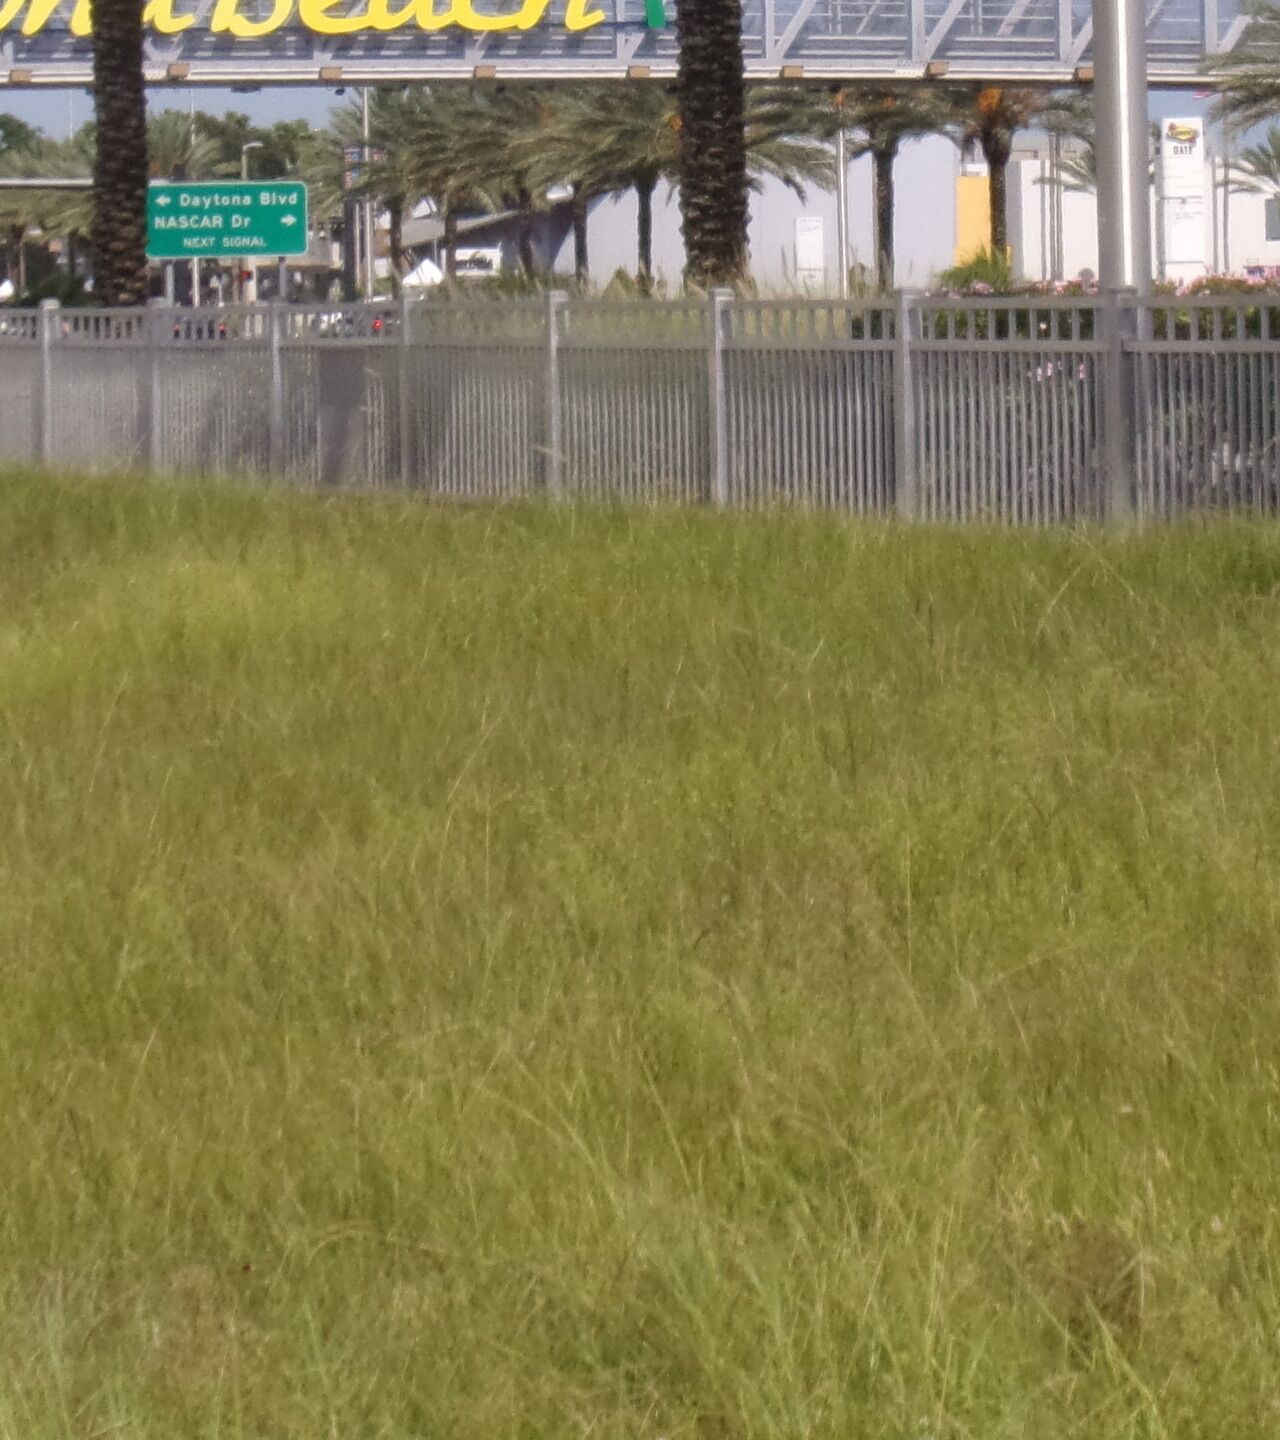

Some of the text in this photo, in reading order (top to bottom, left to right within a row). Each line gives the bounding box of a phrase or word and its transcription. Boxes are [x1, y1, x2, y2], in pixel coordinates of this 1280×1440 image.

[180, 191, 298, 208] Daytona Blvd
[154, 214, 251, 229] NASCAR Dr
[183, 236, 267, 248] NEXT SIGNAL
